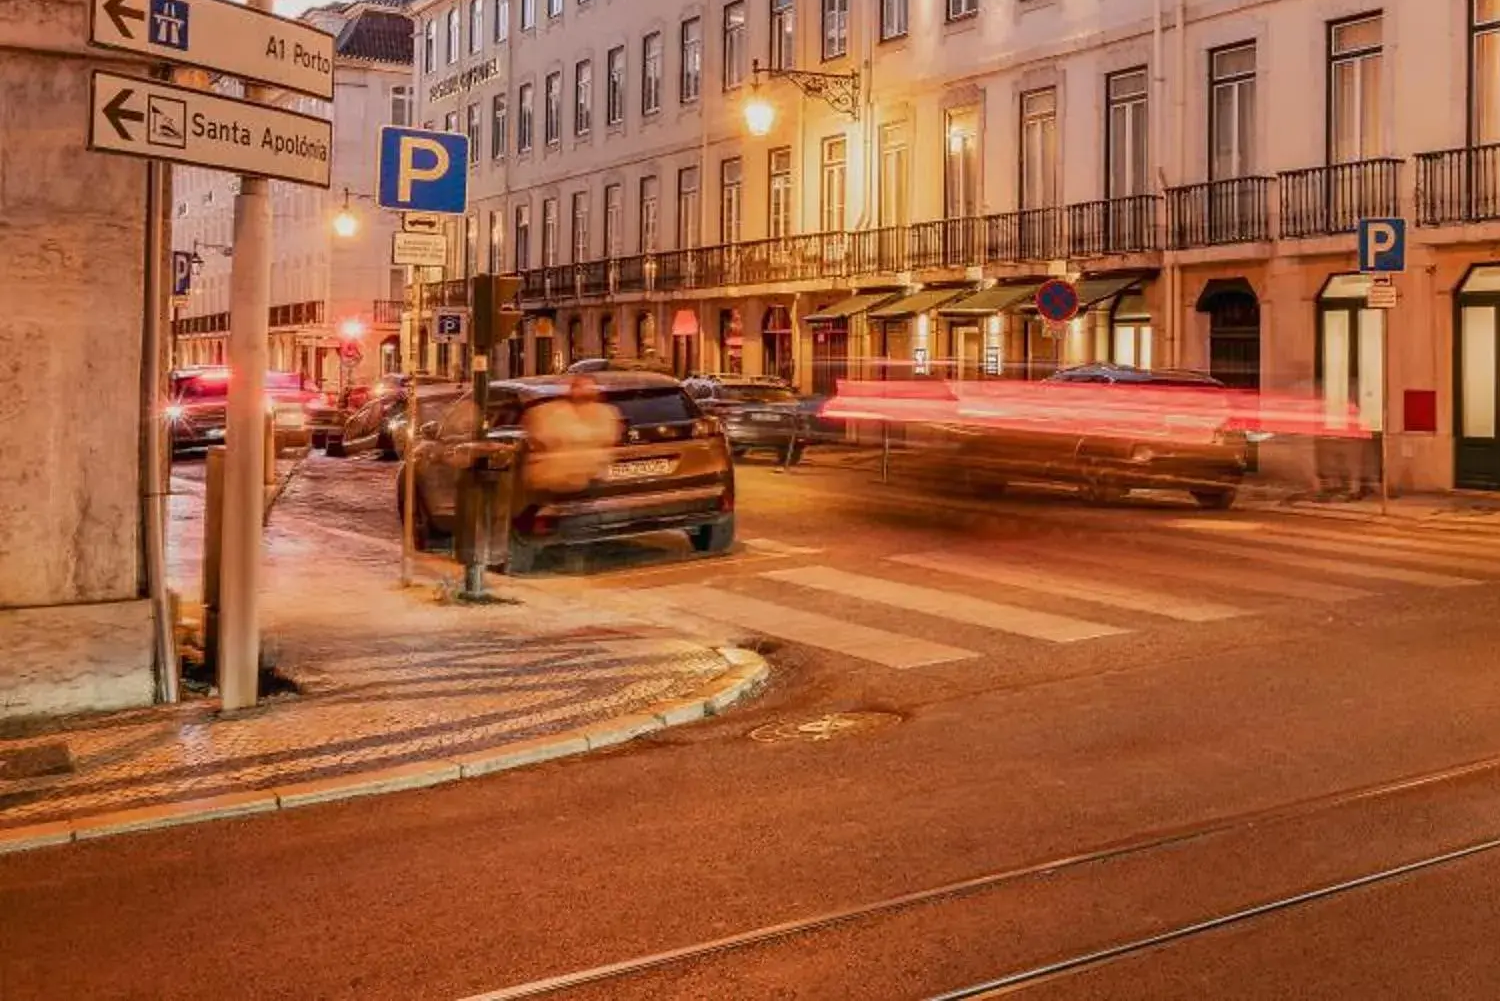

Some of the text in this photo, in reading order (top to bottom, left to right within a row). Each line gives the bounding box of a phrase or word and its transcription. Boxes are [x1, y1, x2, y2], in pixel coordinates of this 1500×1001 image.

[265, 35, 331, 74] A1 Porto
[192, 112, 327, 162] Santa Apolónia
[398, 136, 450, 202] P
[1367, 222, 1396, 267] P
[175, 254, 188, 292] P
